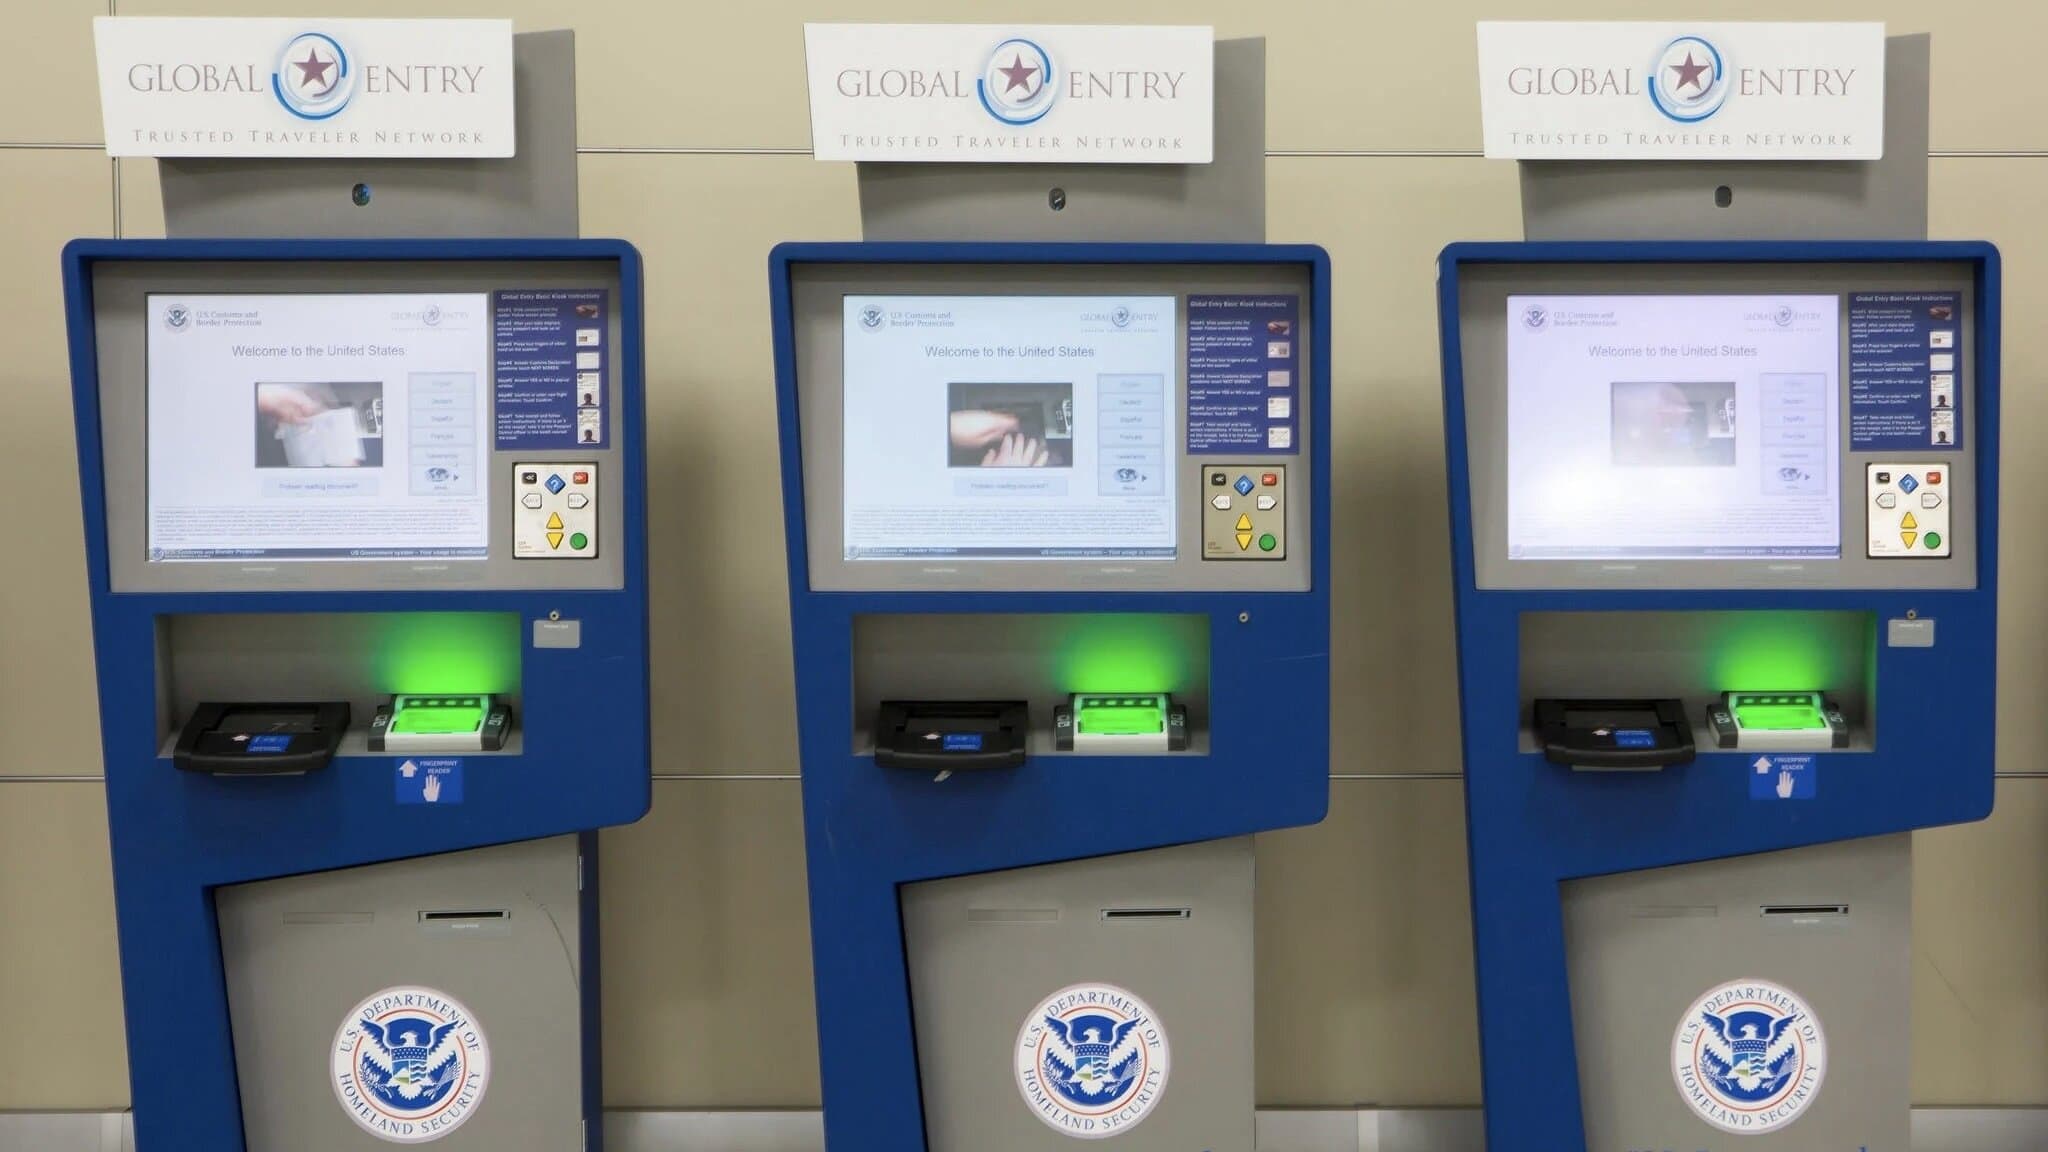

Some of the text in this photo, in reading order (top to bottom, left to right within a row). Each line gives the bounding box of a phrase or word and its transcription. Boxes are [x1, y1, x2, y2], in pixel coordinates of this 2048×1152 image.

[128, 63, 484, 94] GLOBAL ENTRY
[836, 70, 1185, 99] GLOBAL ENTRY
[1508, 67, 1856, 96] GLOBAL ENTRY
[133, 129, 483, 145] TRUSTED TRAVELER NETWORK
[840, 134, 1184, 149] TRUSTED TRAVELER NETWORK
[1511, 132, 1852, 146] TRUSTED TRAVELER NETWORK
[232, 344, 405, 357] Welcome to the United States
[925, 345, 1095, 358] Welcome to the United States
[1588, 345, 1758, 358] Welcome to the United States
[340, 993, 481, 1053] U.S. DEPARTMENT OF
[1024, 991, 1161, 1049] U.S. DEPARTMENT OF
[1681, 987, 1817, 1045] U.S. DEPARTMENT OF
[340, 1071, 481, 1135] HOMELAND SECURITY
[1023, 1068, 1161, 1130] HOMELAND SECURITY
[1680, 1063, 1818, 1126] HOMELAND SECURITY
